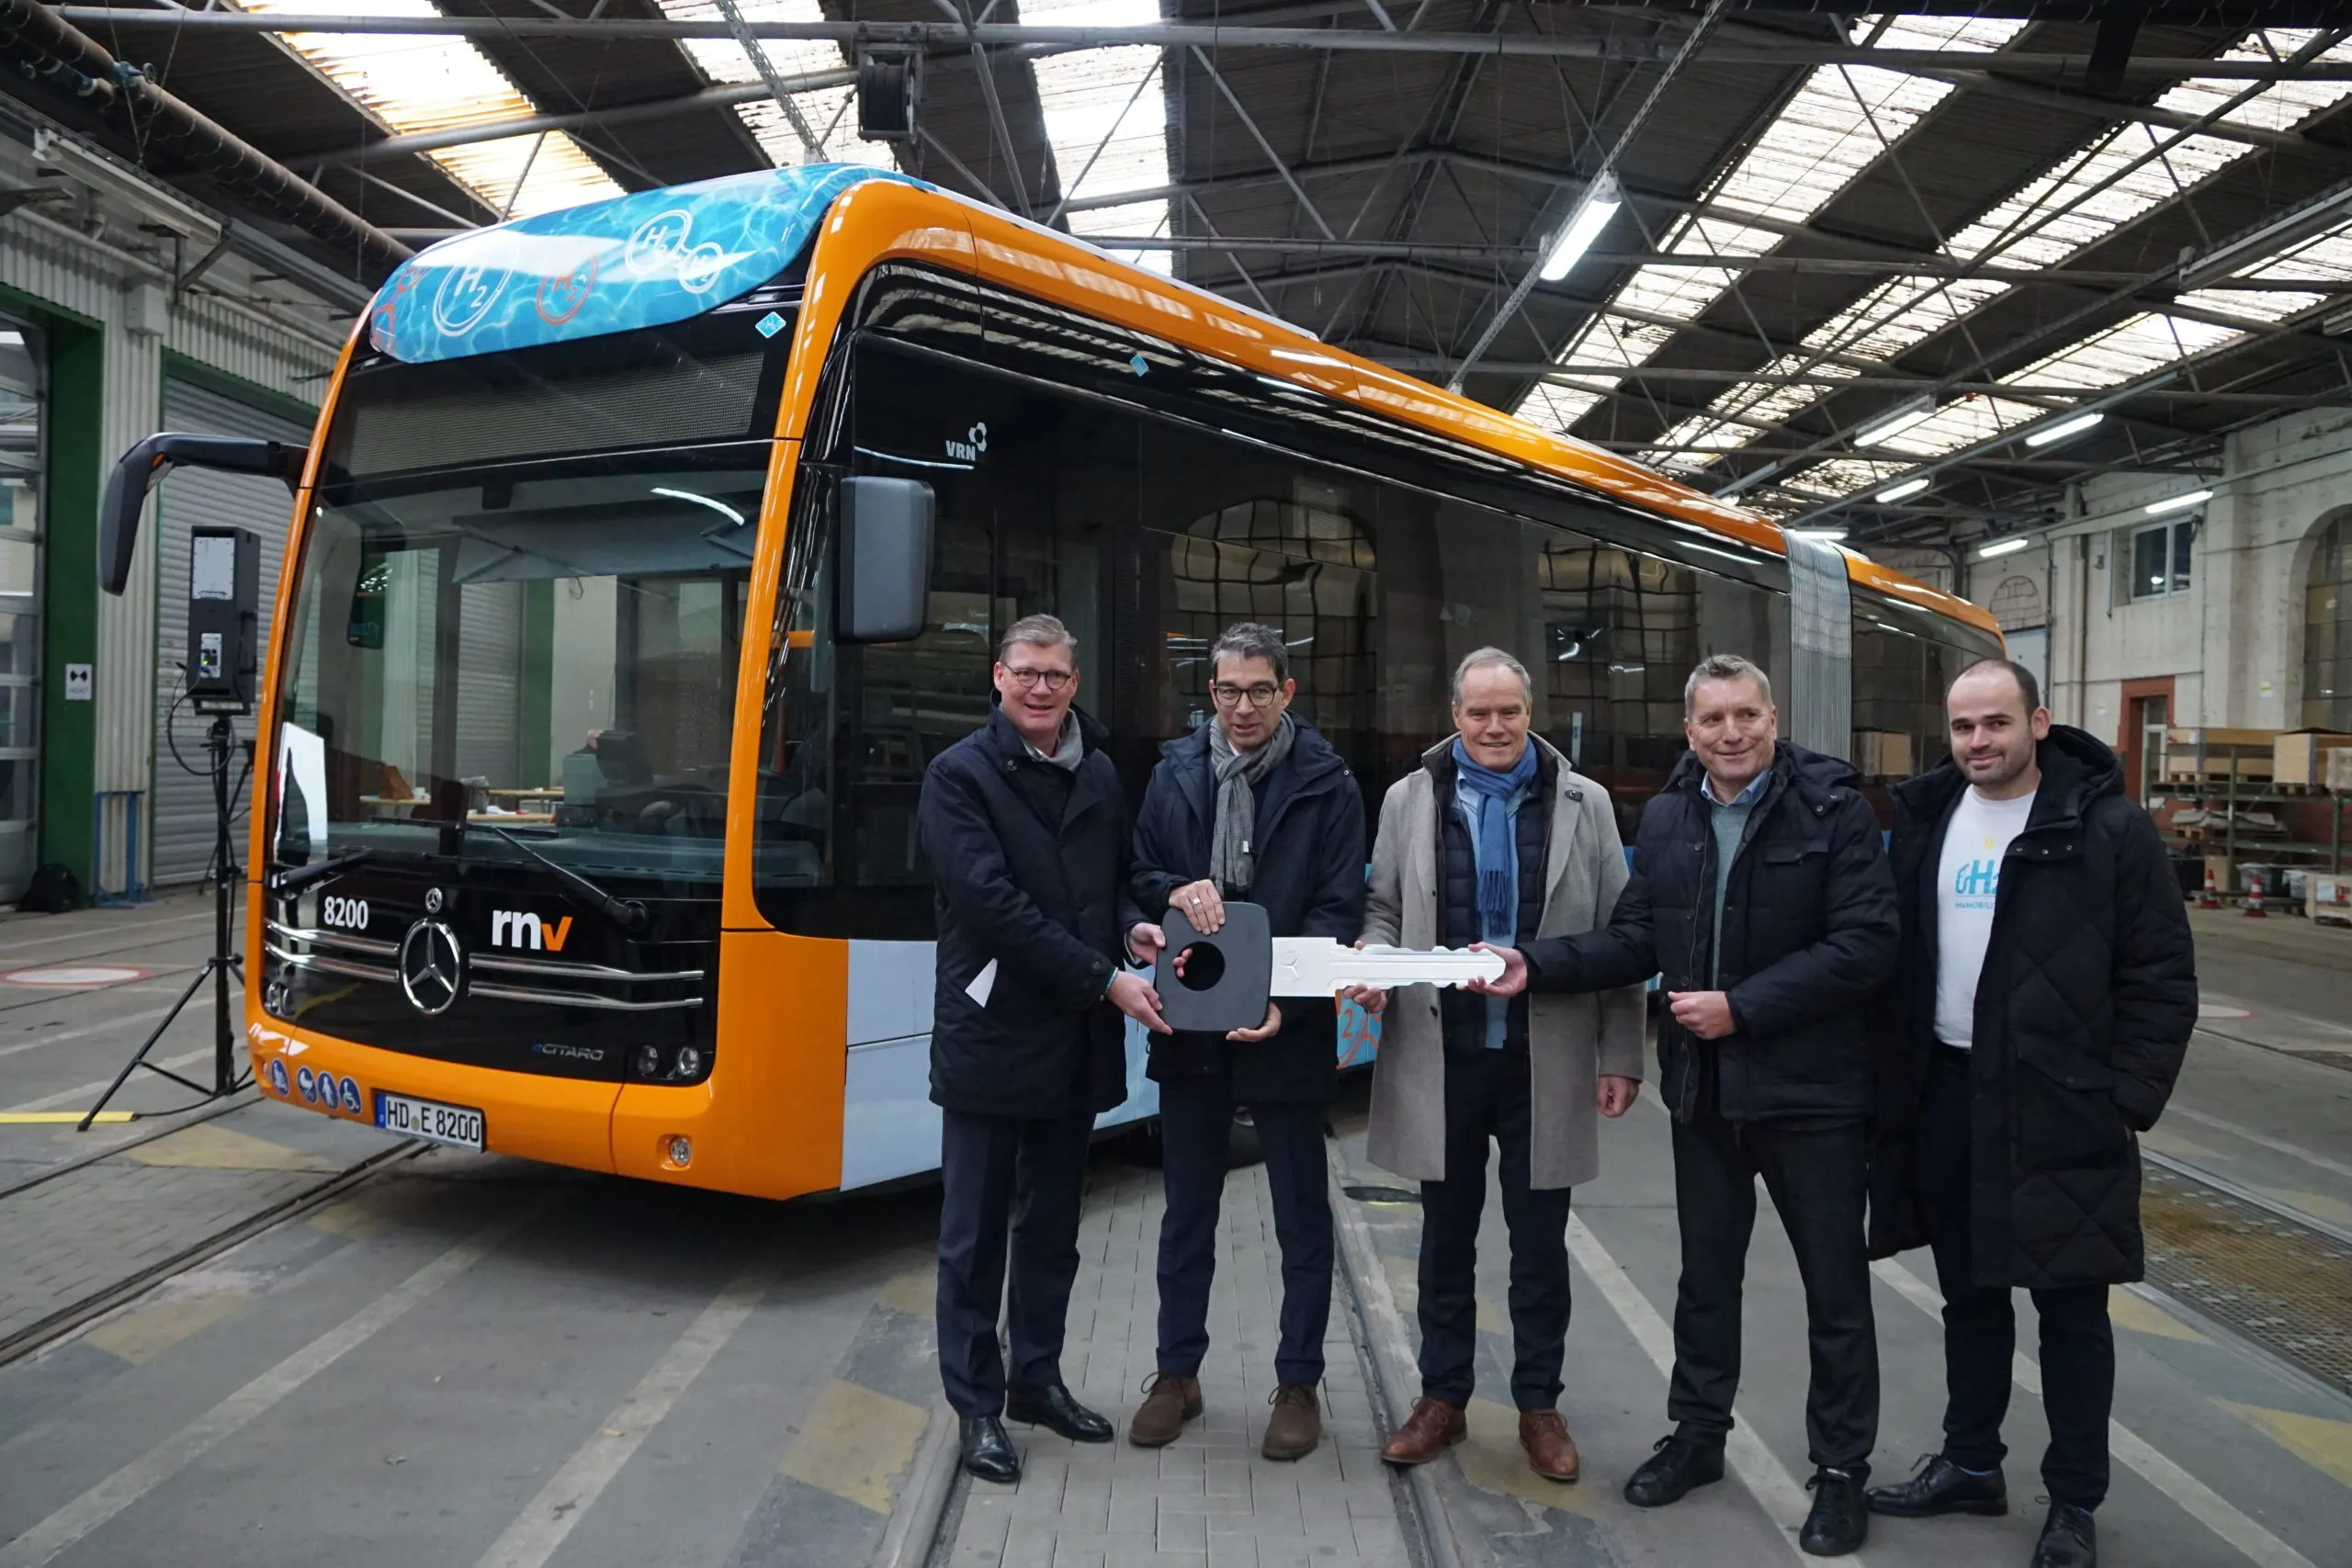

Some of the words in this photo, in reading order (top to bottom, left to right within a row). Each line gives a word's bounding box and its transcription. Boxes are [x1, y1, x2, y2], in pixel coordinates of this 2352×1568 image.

[945, 440, 976, 461] VRN
[323, 896, 368, 930] 8200
[492, 909, 573, 952] rnv
[387, 1100, 410, 1129] HD
[421, 1106, 432, 1134] E
[435, 1110, 480, 1143] 8200
